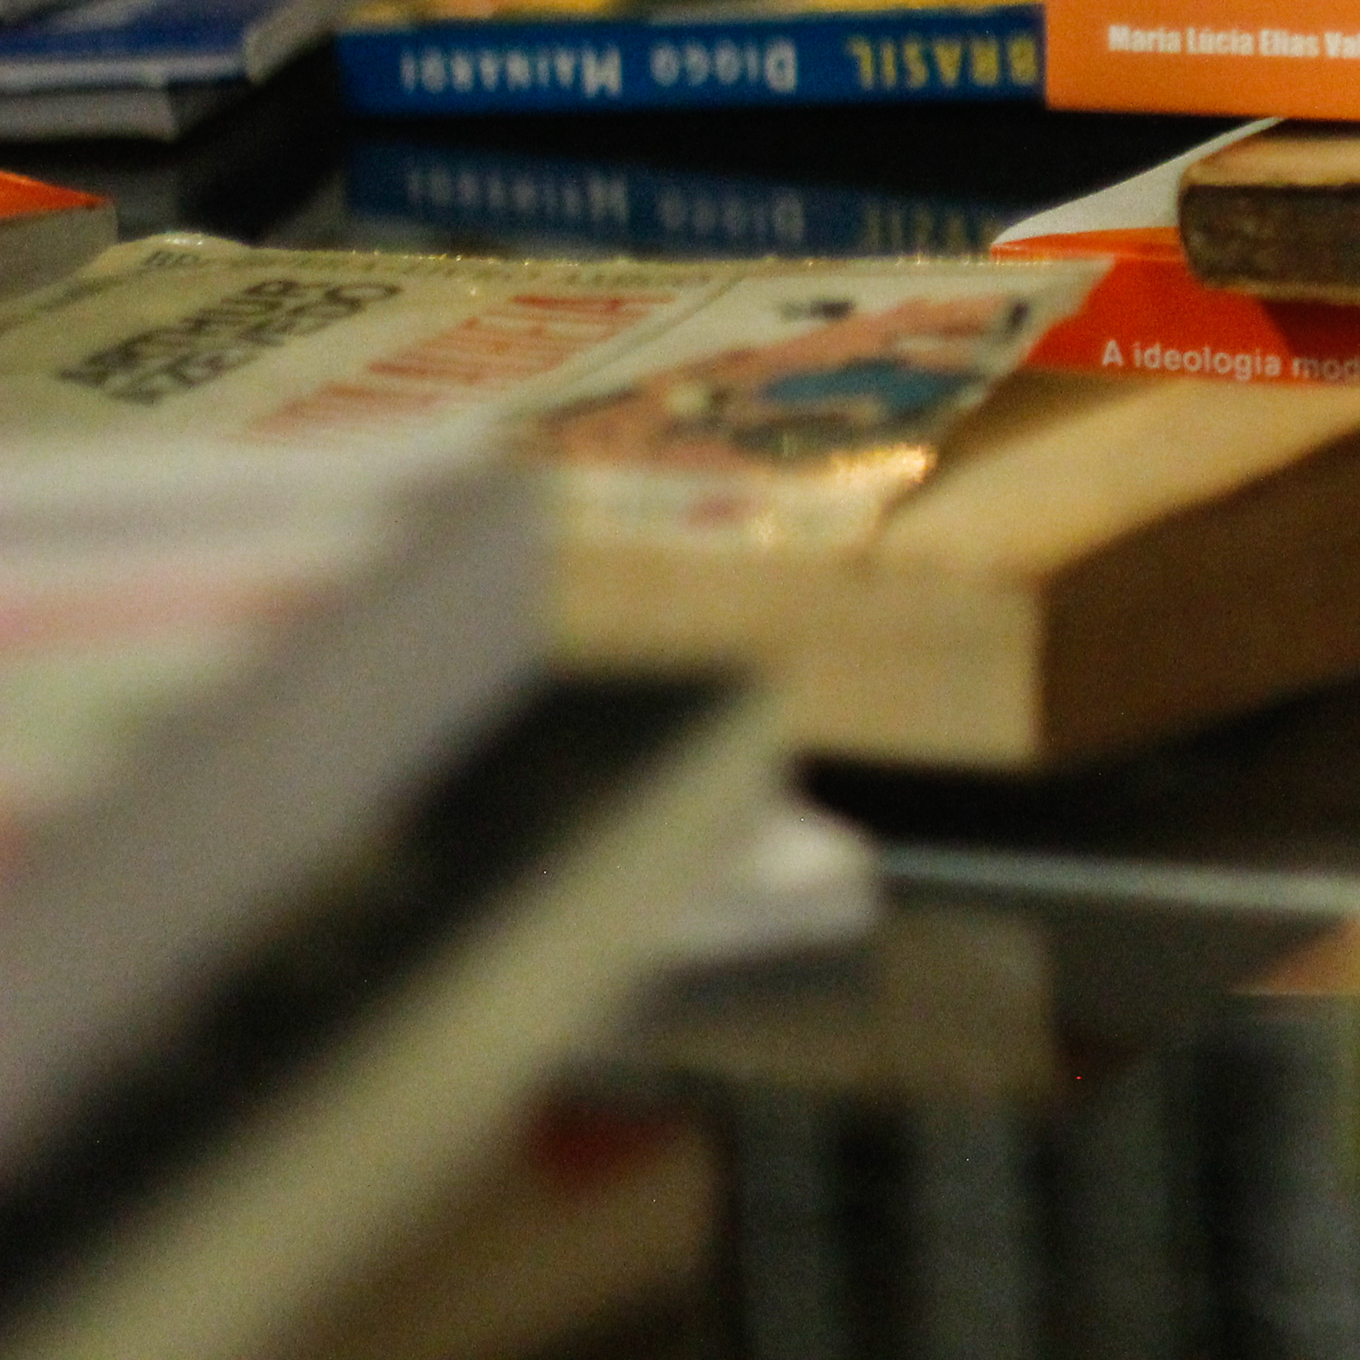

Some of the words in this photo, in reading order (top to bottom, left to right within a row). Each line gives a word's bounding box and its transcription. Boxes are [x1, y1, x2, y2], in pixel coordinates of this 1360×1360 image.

[847, 33, 1038, 89] BRASIL
[1108, 24, 1181, 52] Maria
[1186, 27, 1254, 55] Lúcia
[1259, 29, 1320, 57] Elias
[1101, 339, 1124, 367] A
[1133, 343, 1281, 381] ideologia
